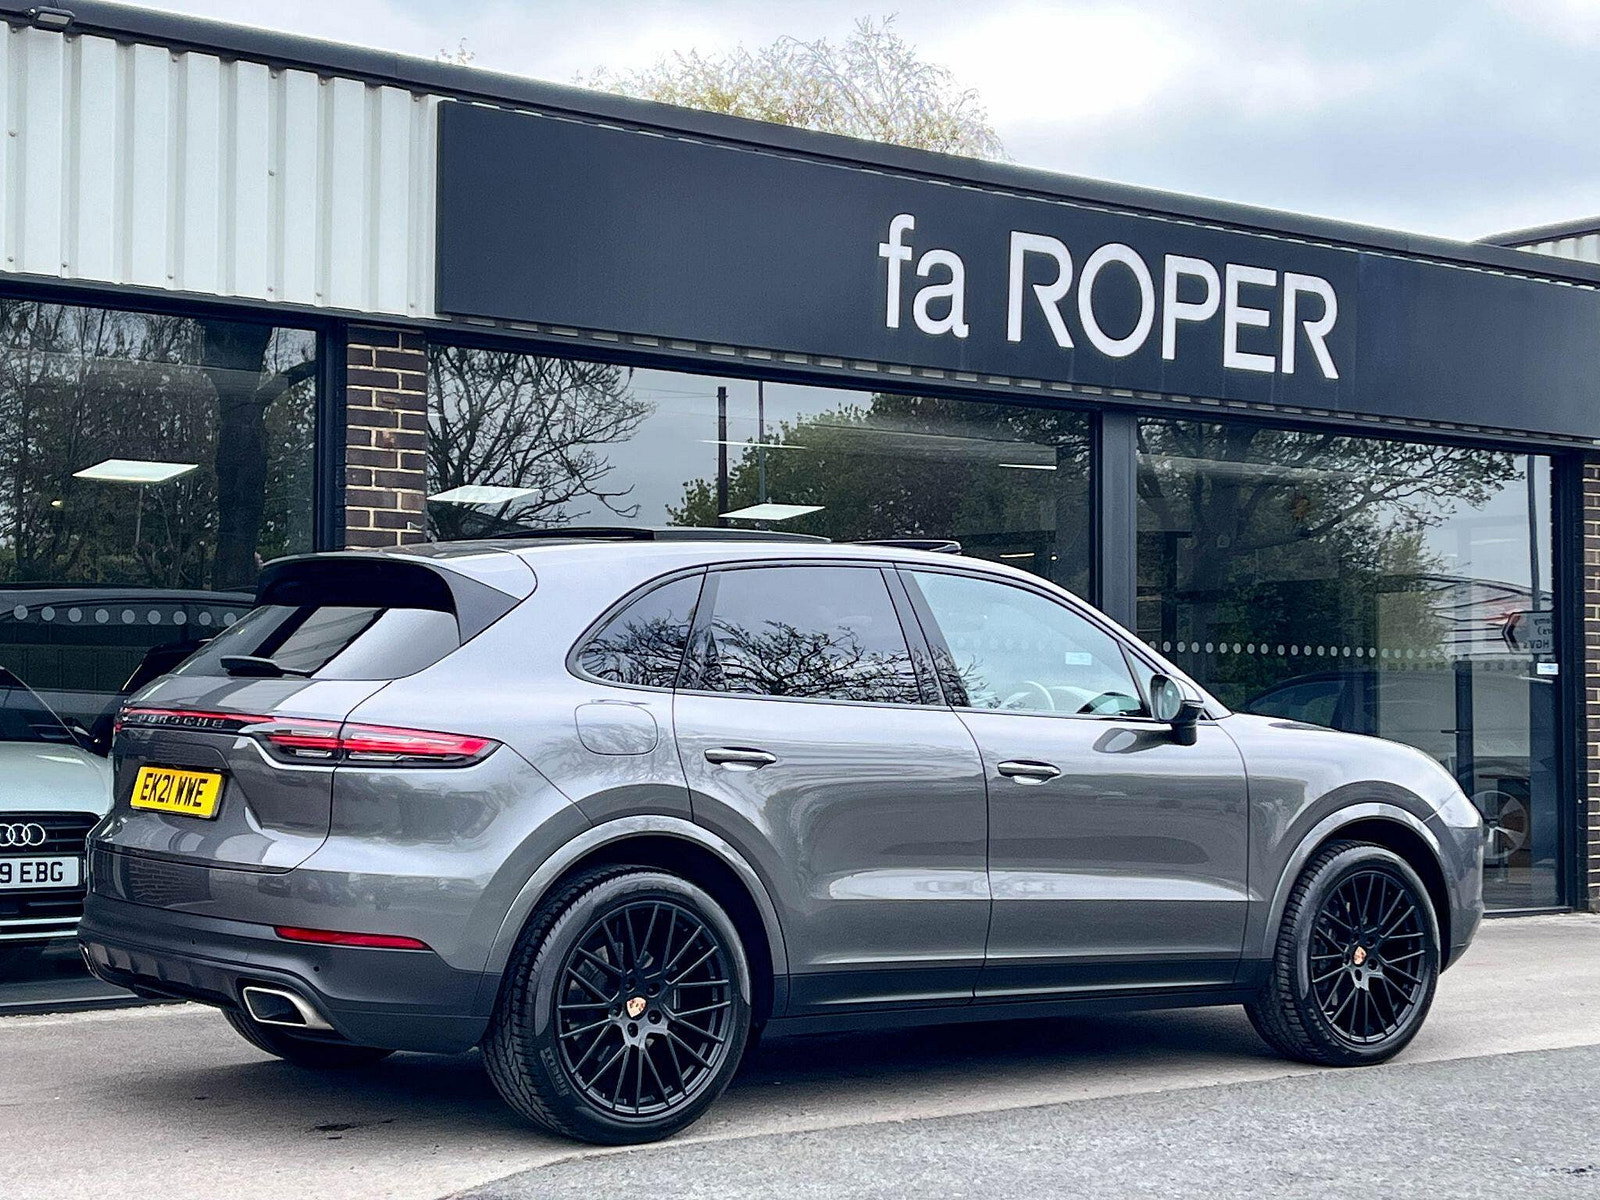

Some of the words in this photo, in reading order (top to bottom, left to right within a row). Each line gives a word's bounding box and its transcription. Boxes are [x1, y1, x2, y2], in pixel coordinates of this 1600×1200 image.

[878, 213, 969, 338] fa
[1007, 230, 1340, 380] ROPER
[138, 714, 225, 729] PORSCHE
[140, 772, 176, 804] EK21
[174, 775, 209, 807] WWE
[19, 861, 64, 883] EBG
